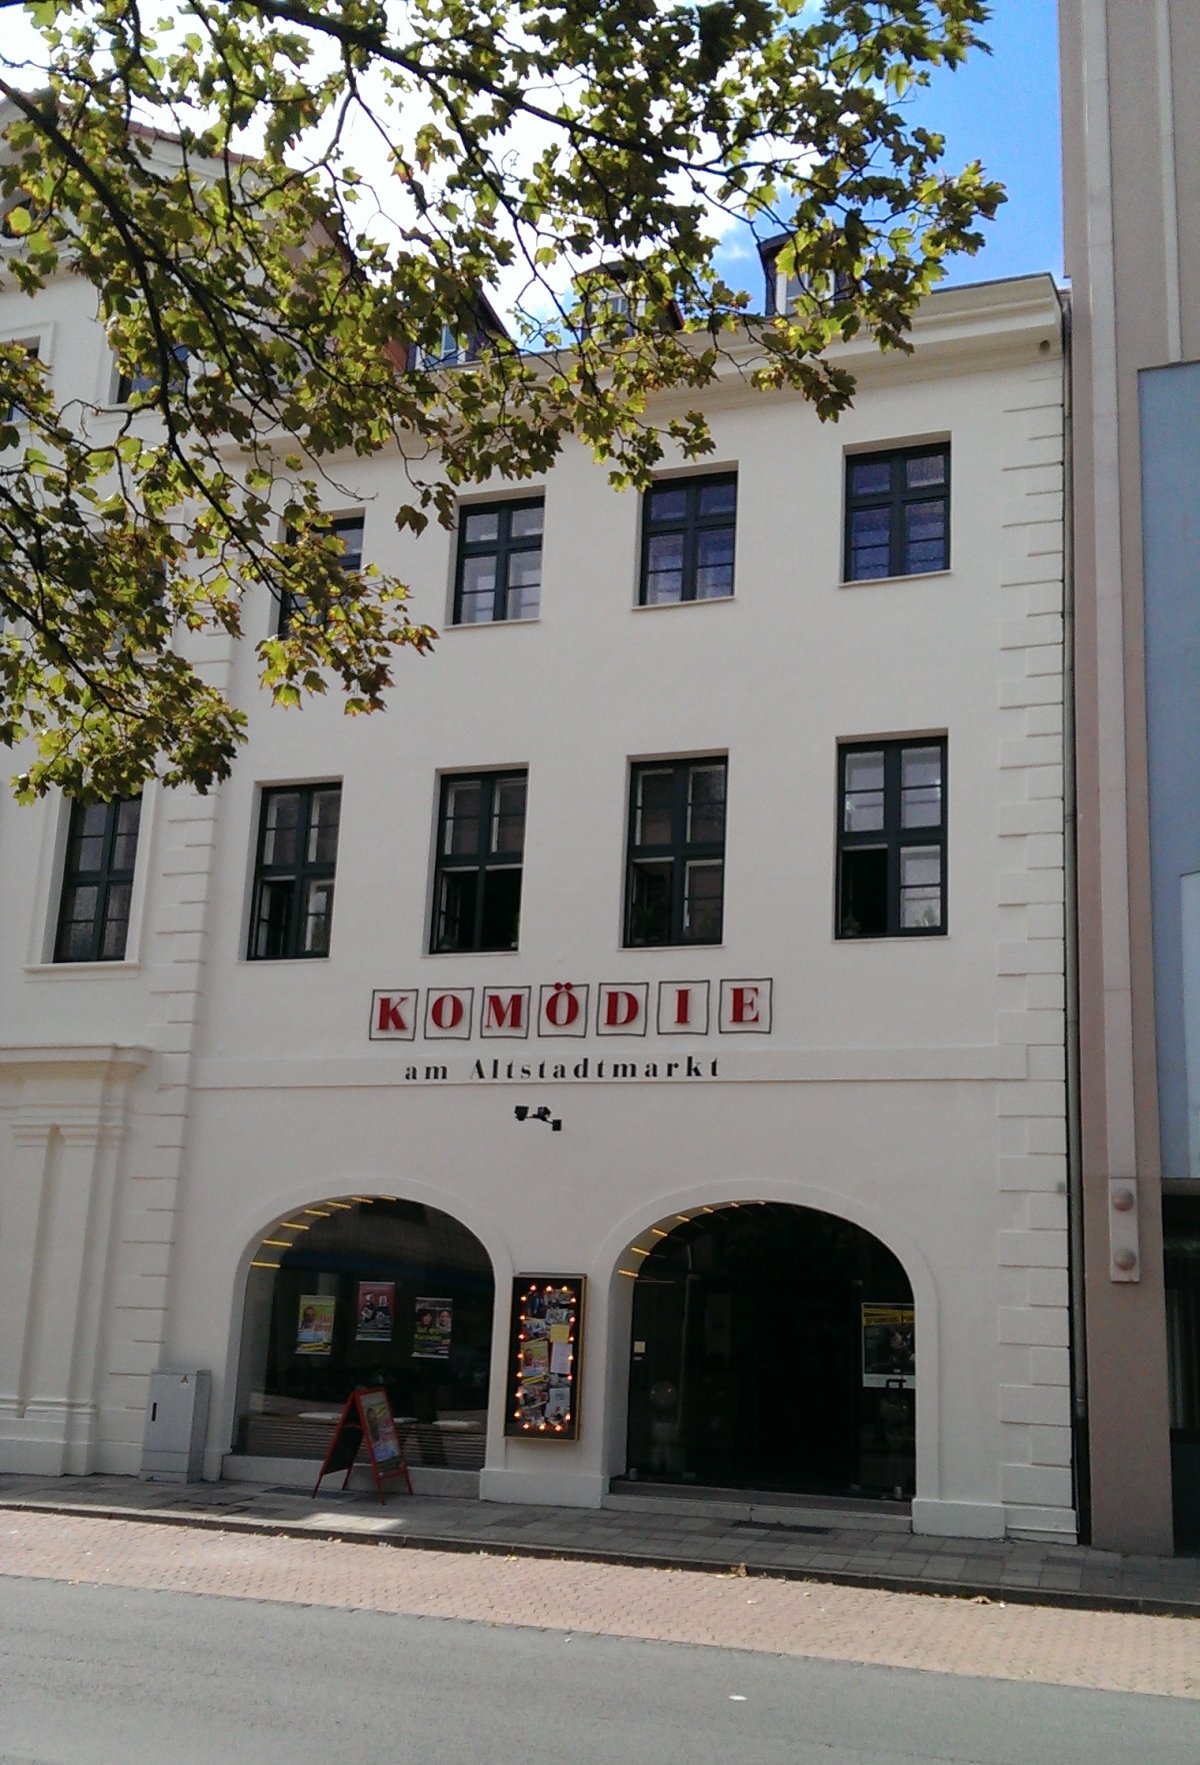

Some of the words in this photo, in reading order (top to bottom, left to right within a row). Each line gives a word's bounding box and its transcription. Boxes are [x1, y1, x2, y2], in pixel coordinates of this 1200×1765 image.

[377, 981, 761, 1031] KOMÖDIE
[405, 1065, 449, 1081] am
[470, 1055, 721, 1081] Altstadtmarkt
